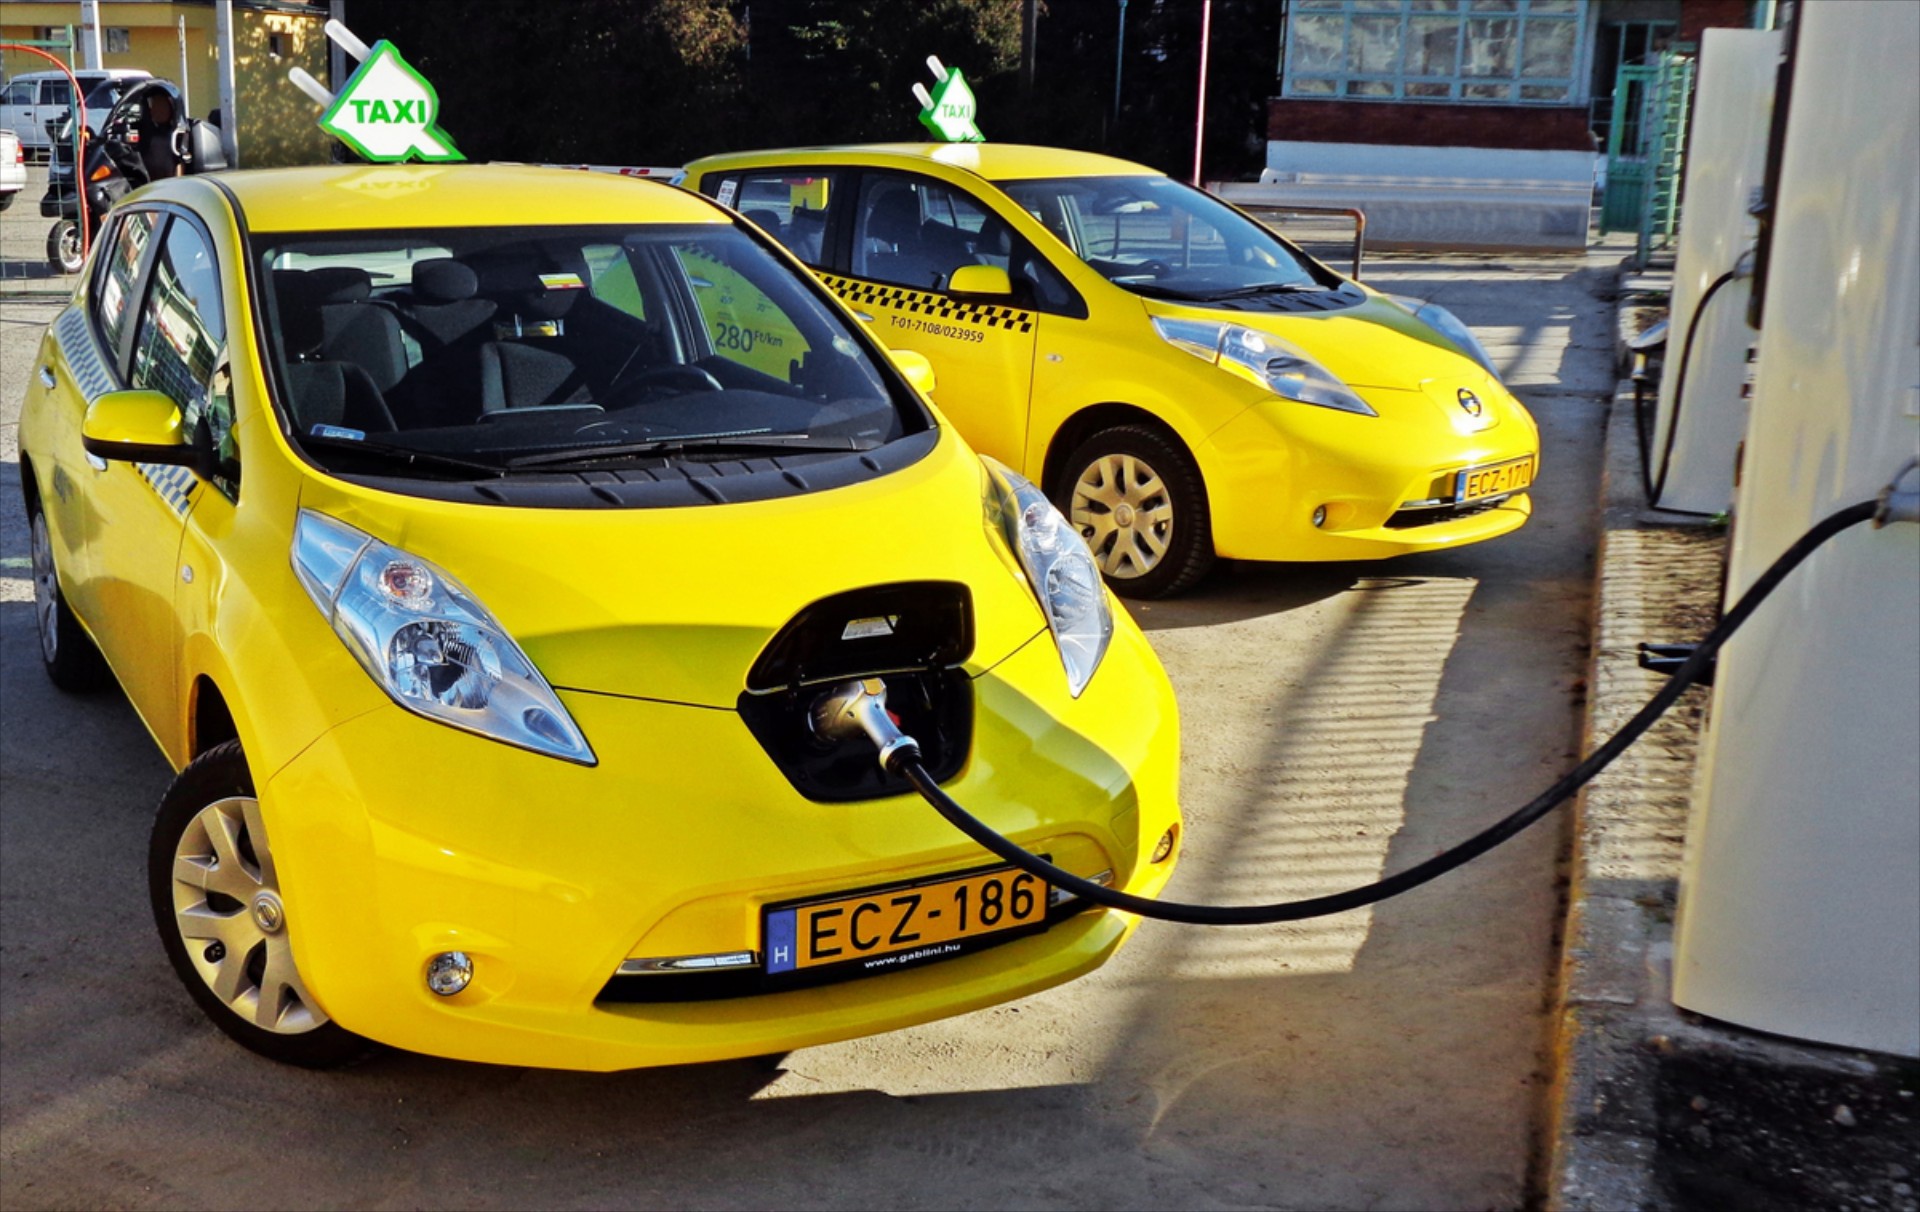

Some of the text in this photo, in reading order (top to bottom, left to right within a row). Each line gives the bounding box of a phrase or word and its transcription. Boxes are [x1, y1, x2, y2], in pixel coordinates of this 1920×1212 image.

[349, 99, 426, 124] TAXI
[942, 103, 971, 118] TAXI
[716, 322, 753, 353] 280
[890, 315, 985, 343] T-01-7108/023959
[1468, 463, 1529, 497] ECZ-170
[810, 873, 1035, 960] ECZ-186
[773, 945, 789, 964] H
[864, 943, 961, 969] www.gablini.hu
